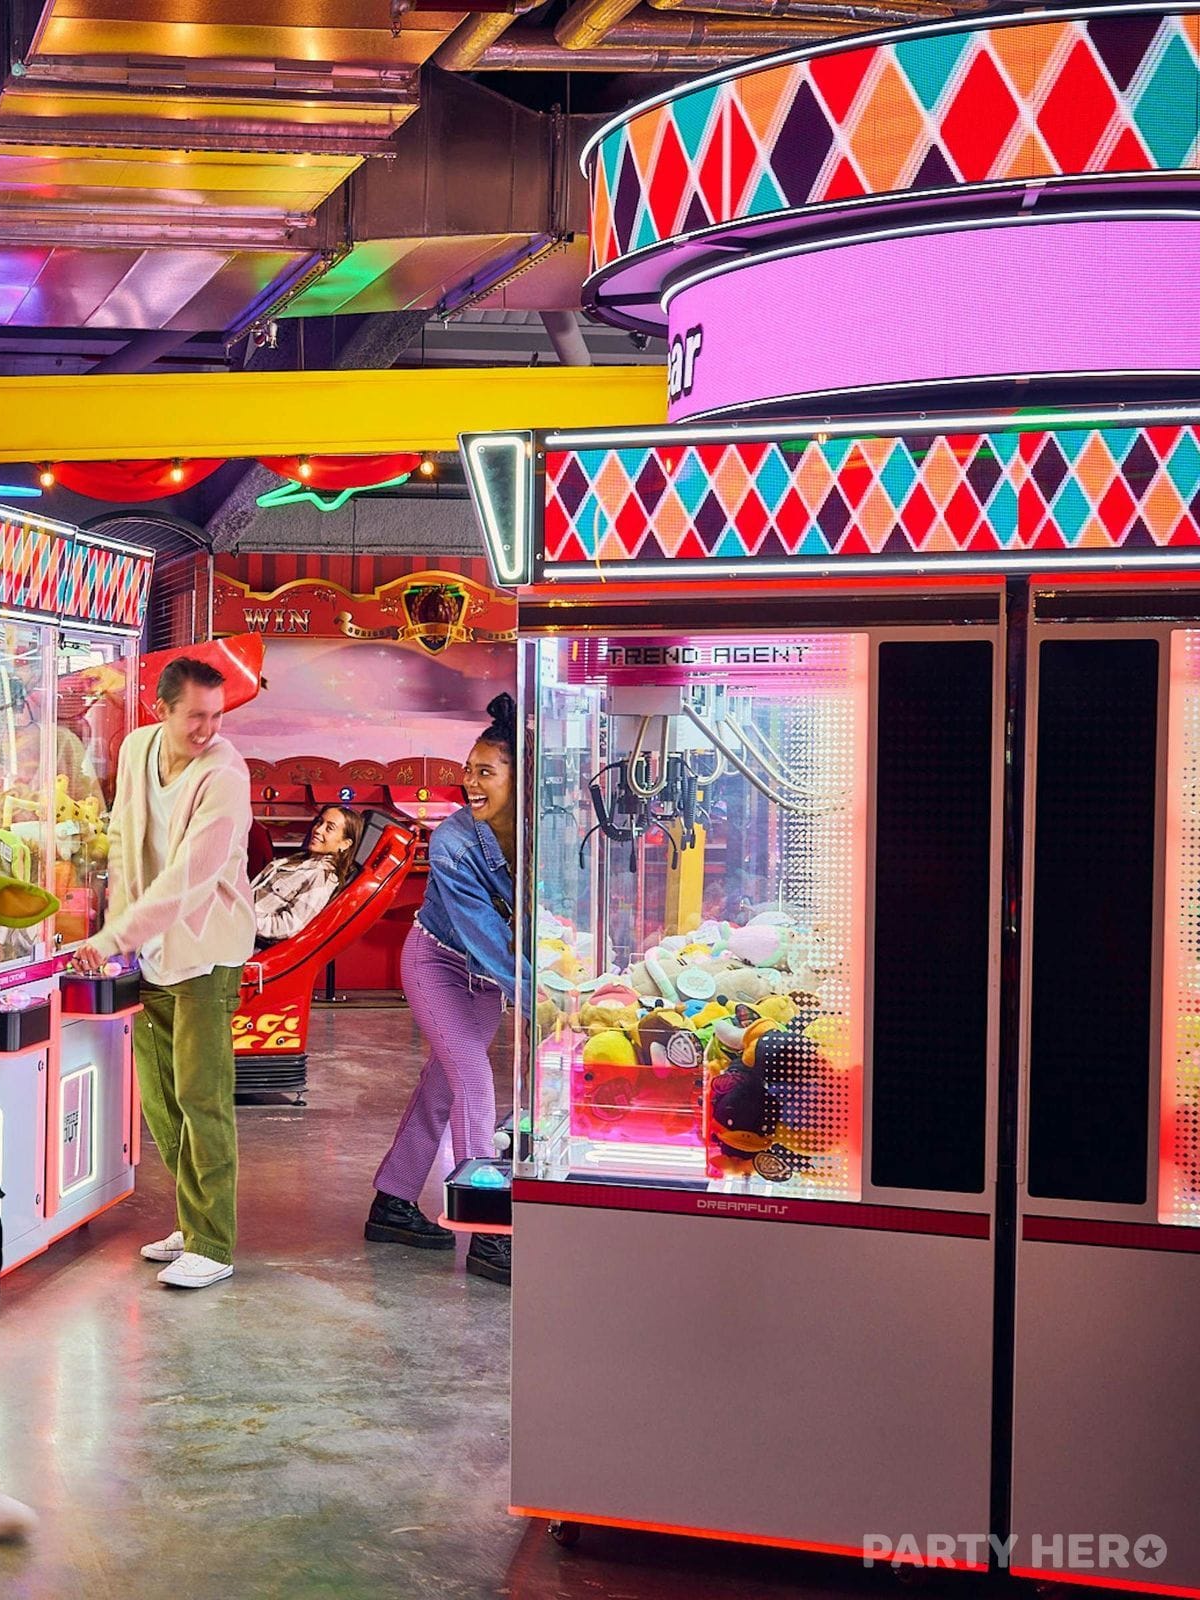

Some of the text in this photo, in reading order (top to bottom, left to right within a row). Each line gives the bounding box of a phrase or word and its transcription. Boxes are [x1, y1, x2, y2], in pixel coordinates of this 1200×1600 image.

[668, 323, 703, 405] ar
[242, 607, 311, 633] WIN
[607, 646, 809, 664] TREND AGENT
[341, 788, 350, 800] 2
[418, 788, 427, 801] 3
